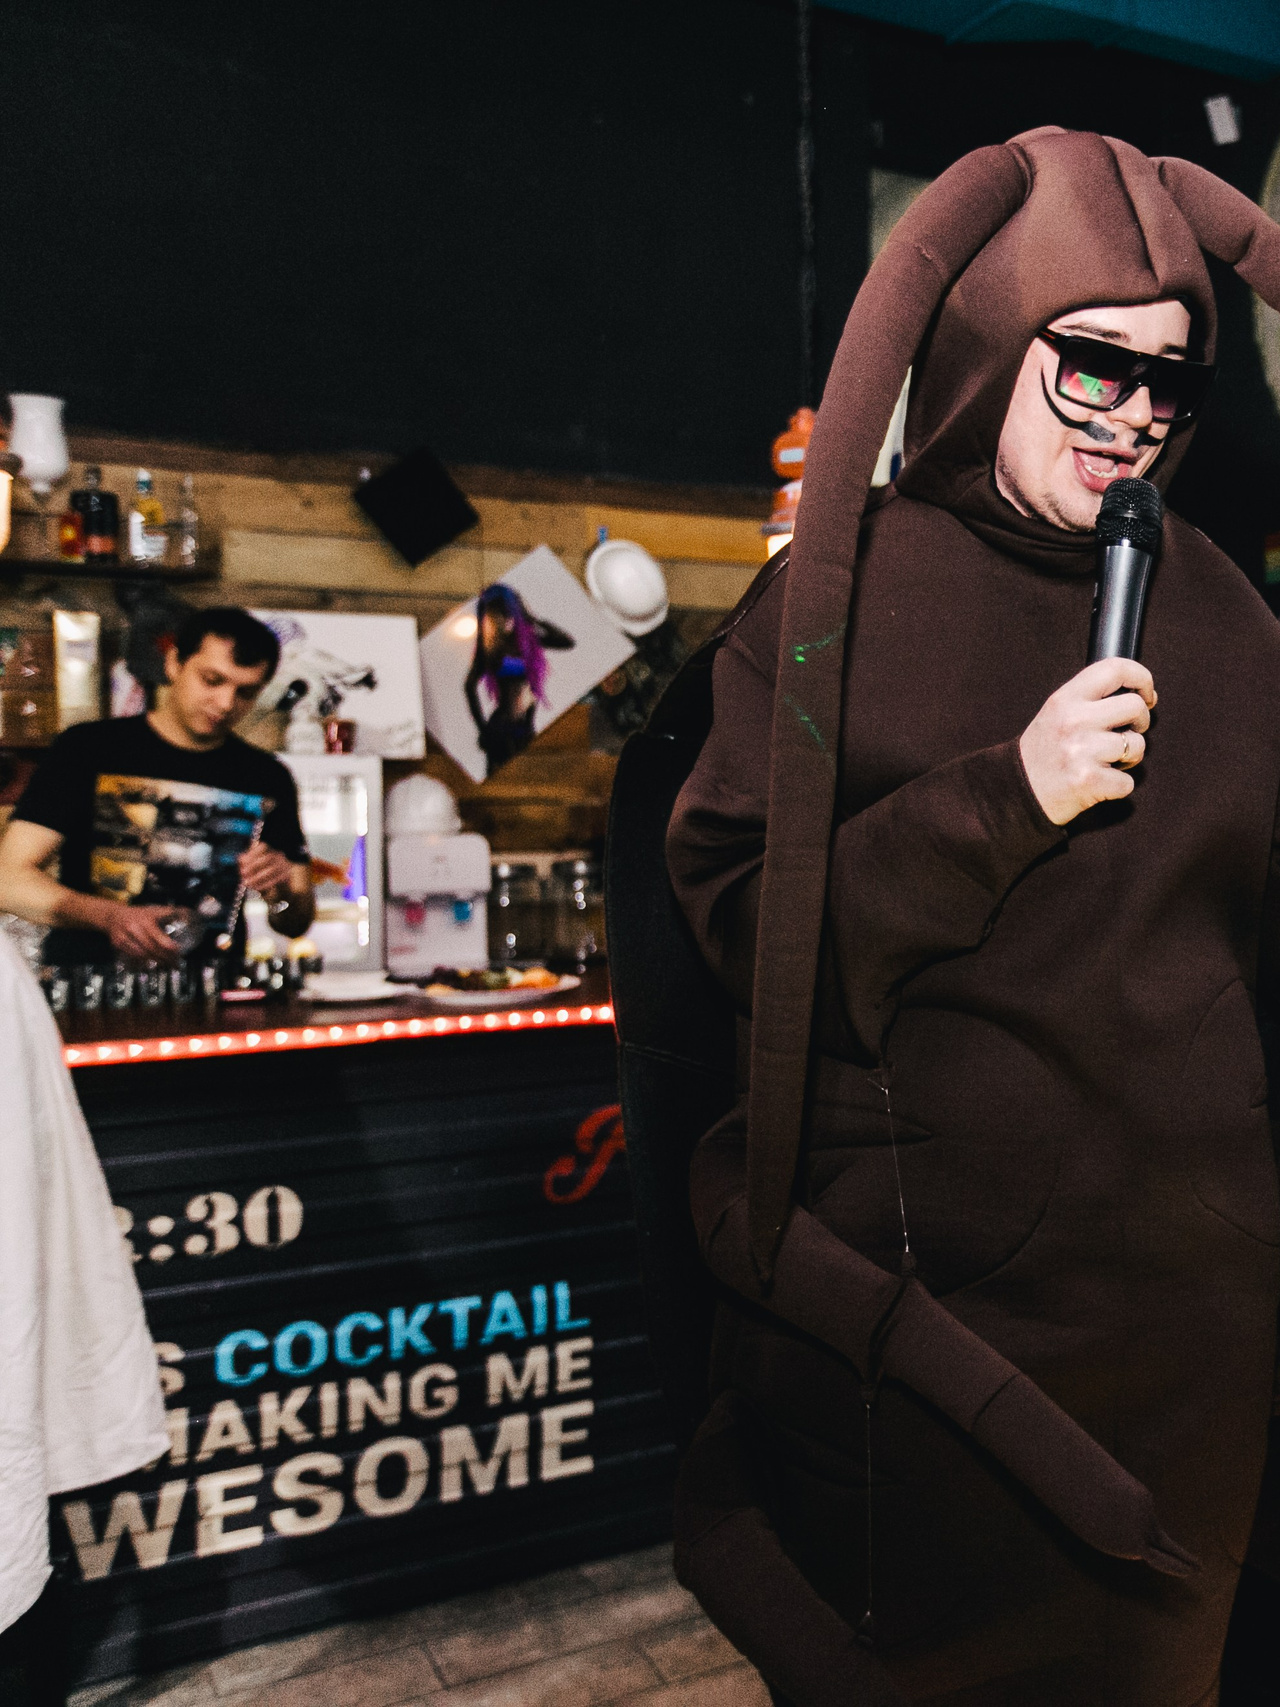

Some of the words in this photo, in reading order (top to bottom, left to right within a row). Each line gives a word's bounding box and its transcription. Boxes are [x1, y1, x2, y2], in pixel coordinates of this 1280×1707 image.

[153, 1340, 187, 1399] S
[215, 1280, 592, 1387] COCKTAIL
[484, 1337, 594, 1408] ME
[62, 1399, 595, 1582] WESOME
